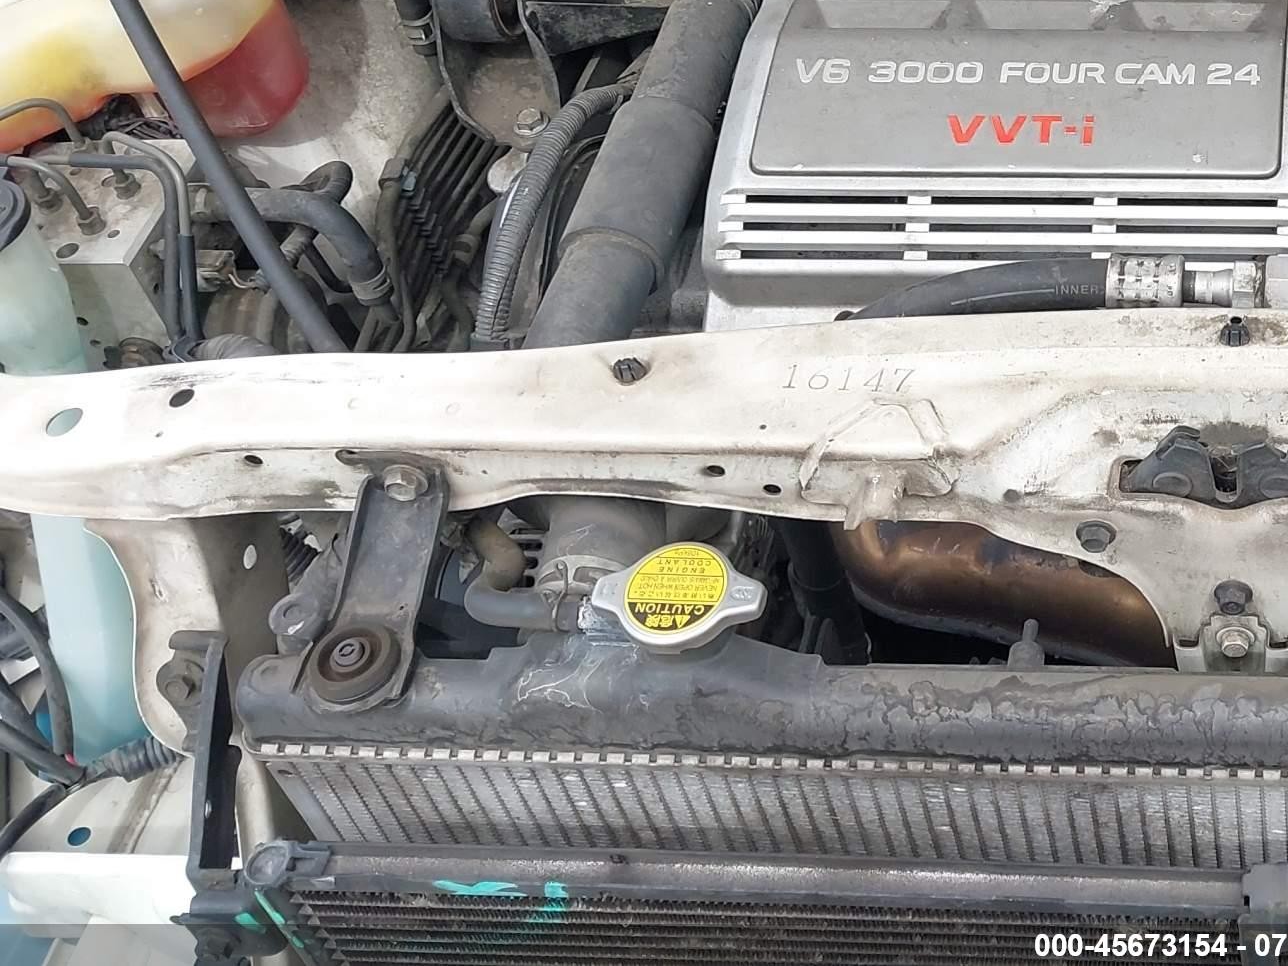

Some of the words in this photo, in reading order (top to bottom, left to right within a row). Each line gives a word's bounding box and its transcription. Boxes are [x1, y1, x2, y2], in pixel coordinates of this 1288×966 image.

[796, 58, 850, 84] V6
[868, 60, 983, 84] 3000
[1000, 61, 1105, 85] FOUR
[1115, 62, 1195, 85] CAM
[1207, 63, 1260, 85] 24
[947, 114, 1096, 147] VVT-i
[1056, 286, 1098, 295] INNER
[782, 364, 915, 392] 16147
[656, 559, 712, 567] COOLANT
[635, 603, 704, 615] CAUTION
[644, 614, 674, 628] 危険
